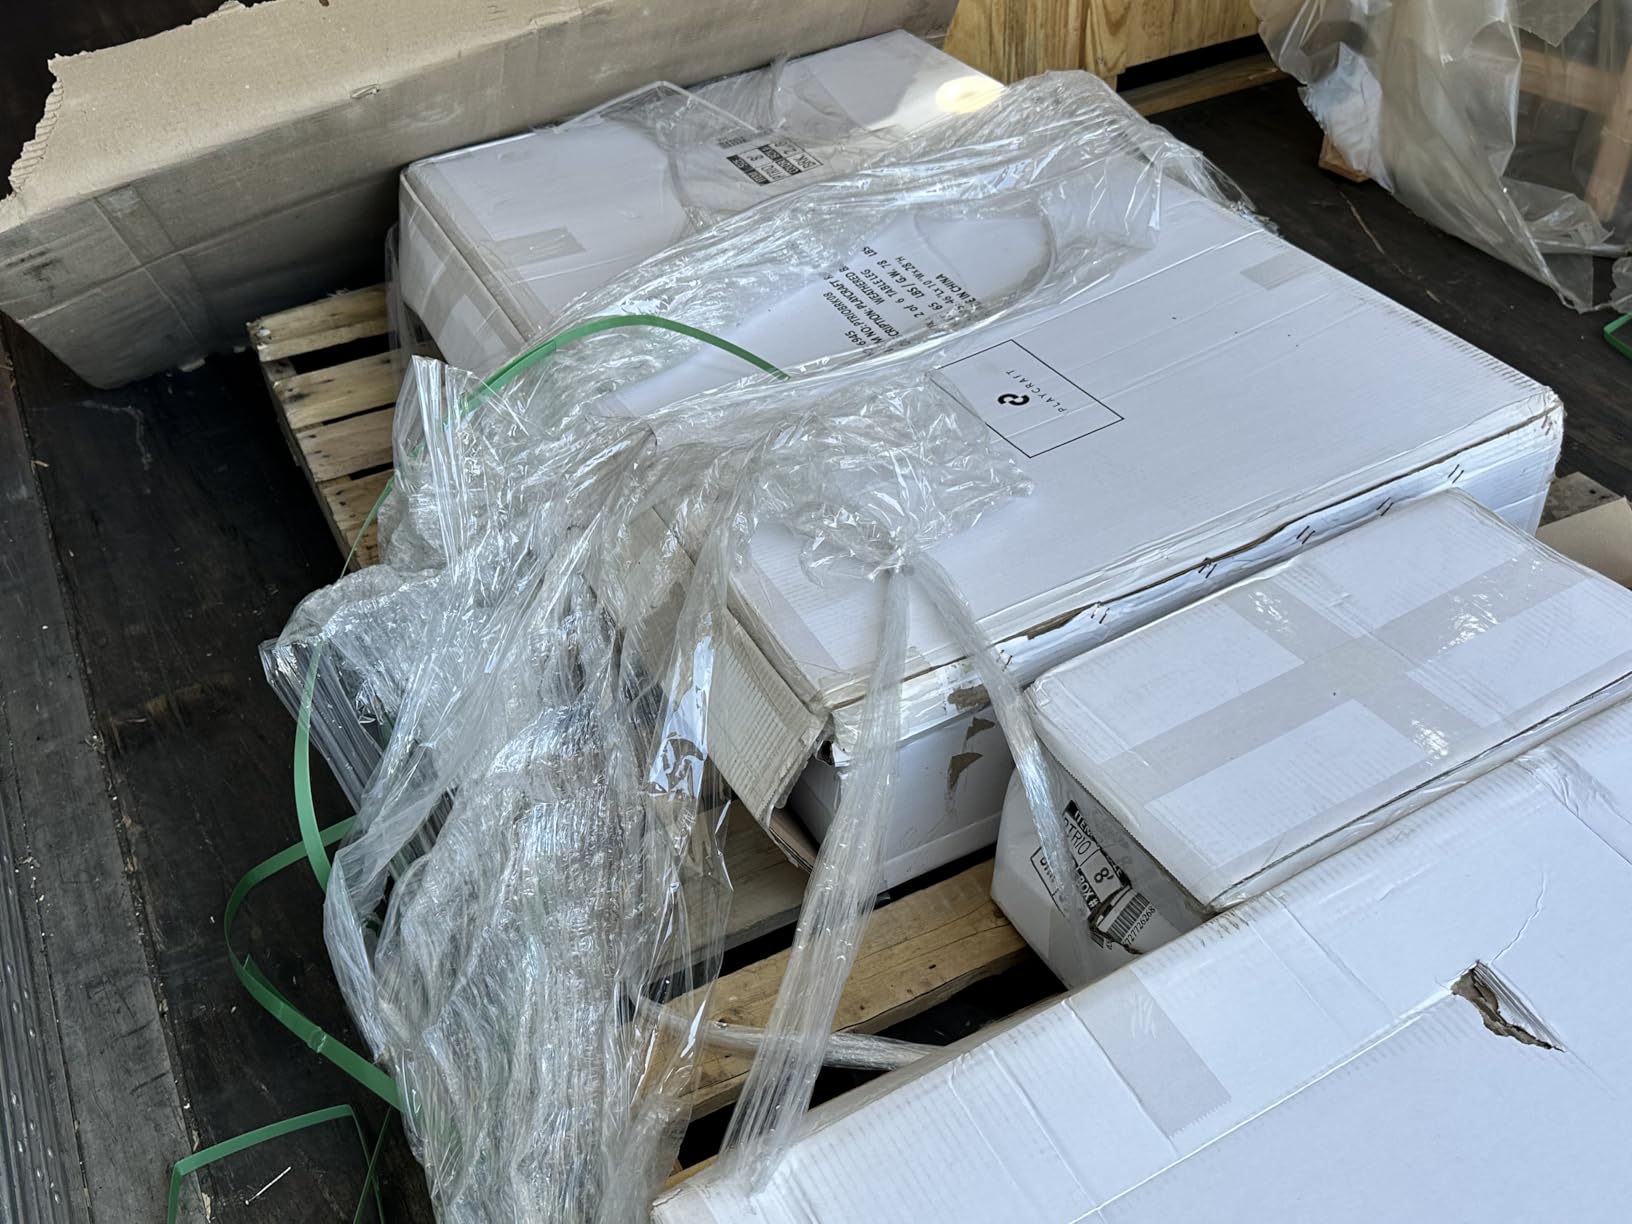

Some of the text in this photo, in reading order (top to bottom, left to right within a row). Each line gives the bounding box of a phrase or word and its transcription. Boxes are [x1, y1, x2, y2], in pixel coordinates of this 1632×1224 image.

[862, 247, 878, 257] LBS
[860, 269, 878, 281] LEG
[829, 280, 867, 310] PLAYCRAFT
[845, 272, 885, 305] WEATHERED
[872, 279, 898, 298] TABLE
[907, 287, 925, 299] LBS
[936, 273, 971, 300] IN CHINA
[903, 304, 918, 312] of
[928, 302, 943, 311] 65
[844, 330, 866, 346] 6945
[1005, 369, 1068, 413] PLAYCRAFT
[1094, 867, 1114, 884] 8'
[1123, 905, 1156, 946] 727726268
